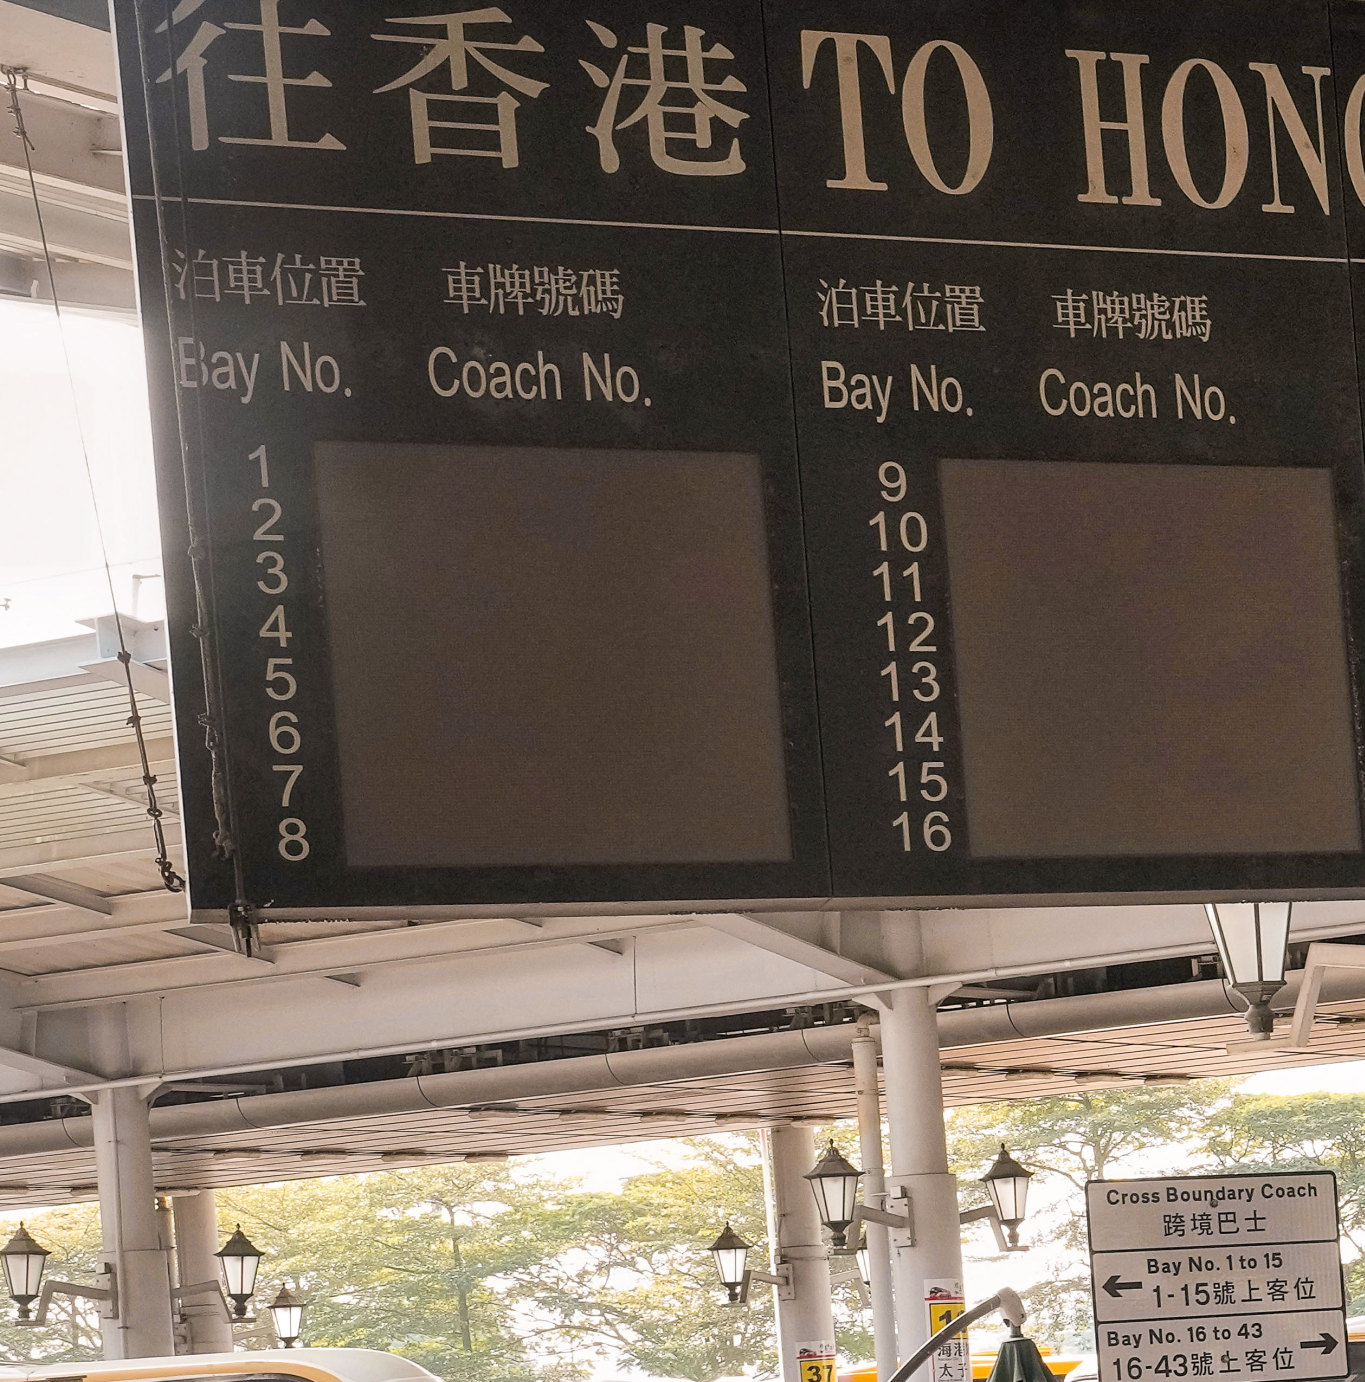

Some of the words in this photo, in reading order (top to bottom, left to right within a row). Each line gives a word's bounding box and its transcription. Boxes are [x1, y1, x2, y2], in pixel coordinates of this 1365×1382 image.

[154, 0, 752, 177] 往香港
[801, 30, 993, 194] TO
[173, 250, 365, 307] 泊車位置
[443, 262, 623, 318] 車牌號碼
[818, 279, 985, 332] 泊車位置
[1052, 289, 1211, 341] 車牌號碼
[179, 337, 259, 404] Bay
[281, 341, 351, 396] No.
[429, 347, 561, 399] Coach
[583, 353, 650, 406] No.
[822, 361, 892, 423] Bay
[911, 364, 972, 416] No.
[1040, 369, 1156, 418] Coach
[1176, 374, 1235, 424] No.
[249, 445, 268, 487] 1
[879, 462, 906, 501] 9
[252, 499, 283, 540] 2
[870, 512, 927, 552] 10
[256, 552, 287, 594] 3
[873, 562, 921, 601] 11
[260, 605, 292, 647] 4
[878, 612, 936, 651] 12
[266, 658, 296, 700] 5
[881, 662, 939, 701] 13
[269, 712, 300, 753] 6
[885, 712, 943, 751] 14
[273, 765, 303, 806] 7
[889, 762, 947, 801] 15
[279, 818, 309, 860] 8
[893, 811, 951, 851] 16
[1107, 1189, 1160, 1205] Cross
[1166, 1186, 1254, 1204] Boundary
[1261, 1183, 1318, 1200] Coach
[1163, 1209, 1267, 1238] 跨境巴士
[1146, 1258, 1182, 1276] Bay
[1188, 1256, 1220, 1273] No.
[1226, 1255, 1234, 1270] 1
[1239, 1254, 1258, 1270] to
[1263, 1252, 1283, 1269] 15
[1152, 1277, 1317, 1308] 1-15號上客位
[1107, 1331, 1142, 1349] Bay
[1149, 1328, 1181, 1345] No.
[1187, 1326, 1206, 1342] 16
[1212, 1326, 1231, 1340] to
[1237, 1323, 1263, 1339] 43
[807, 1365, 833, 1382] 37
[1113, 1346, 1295, 1381] 16-43號上客位
